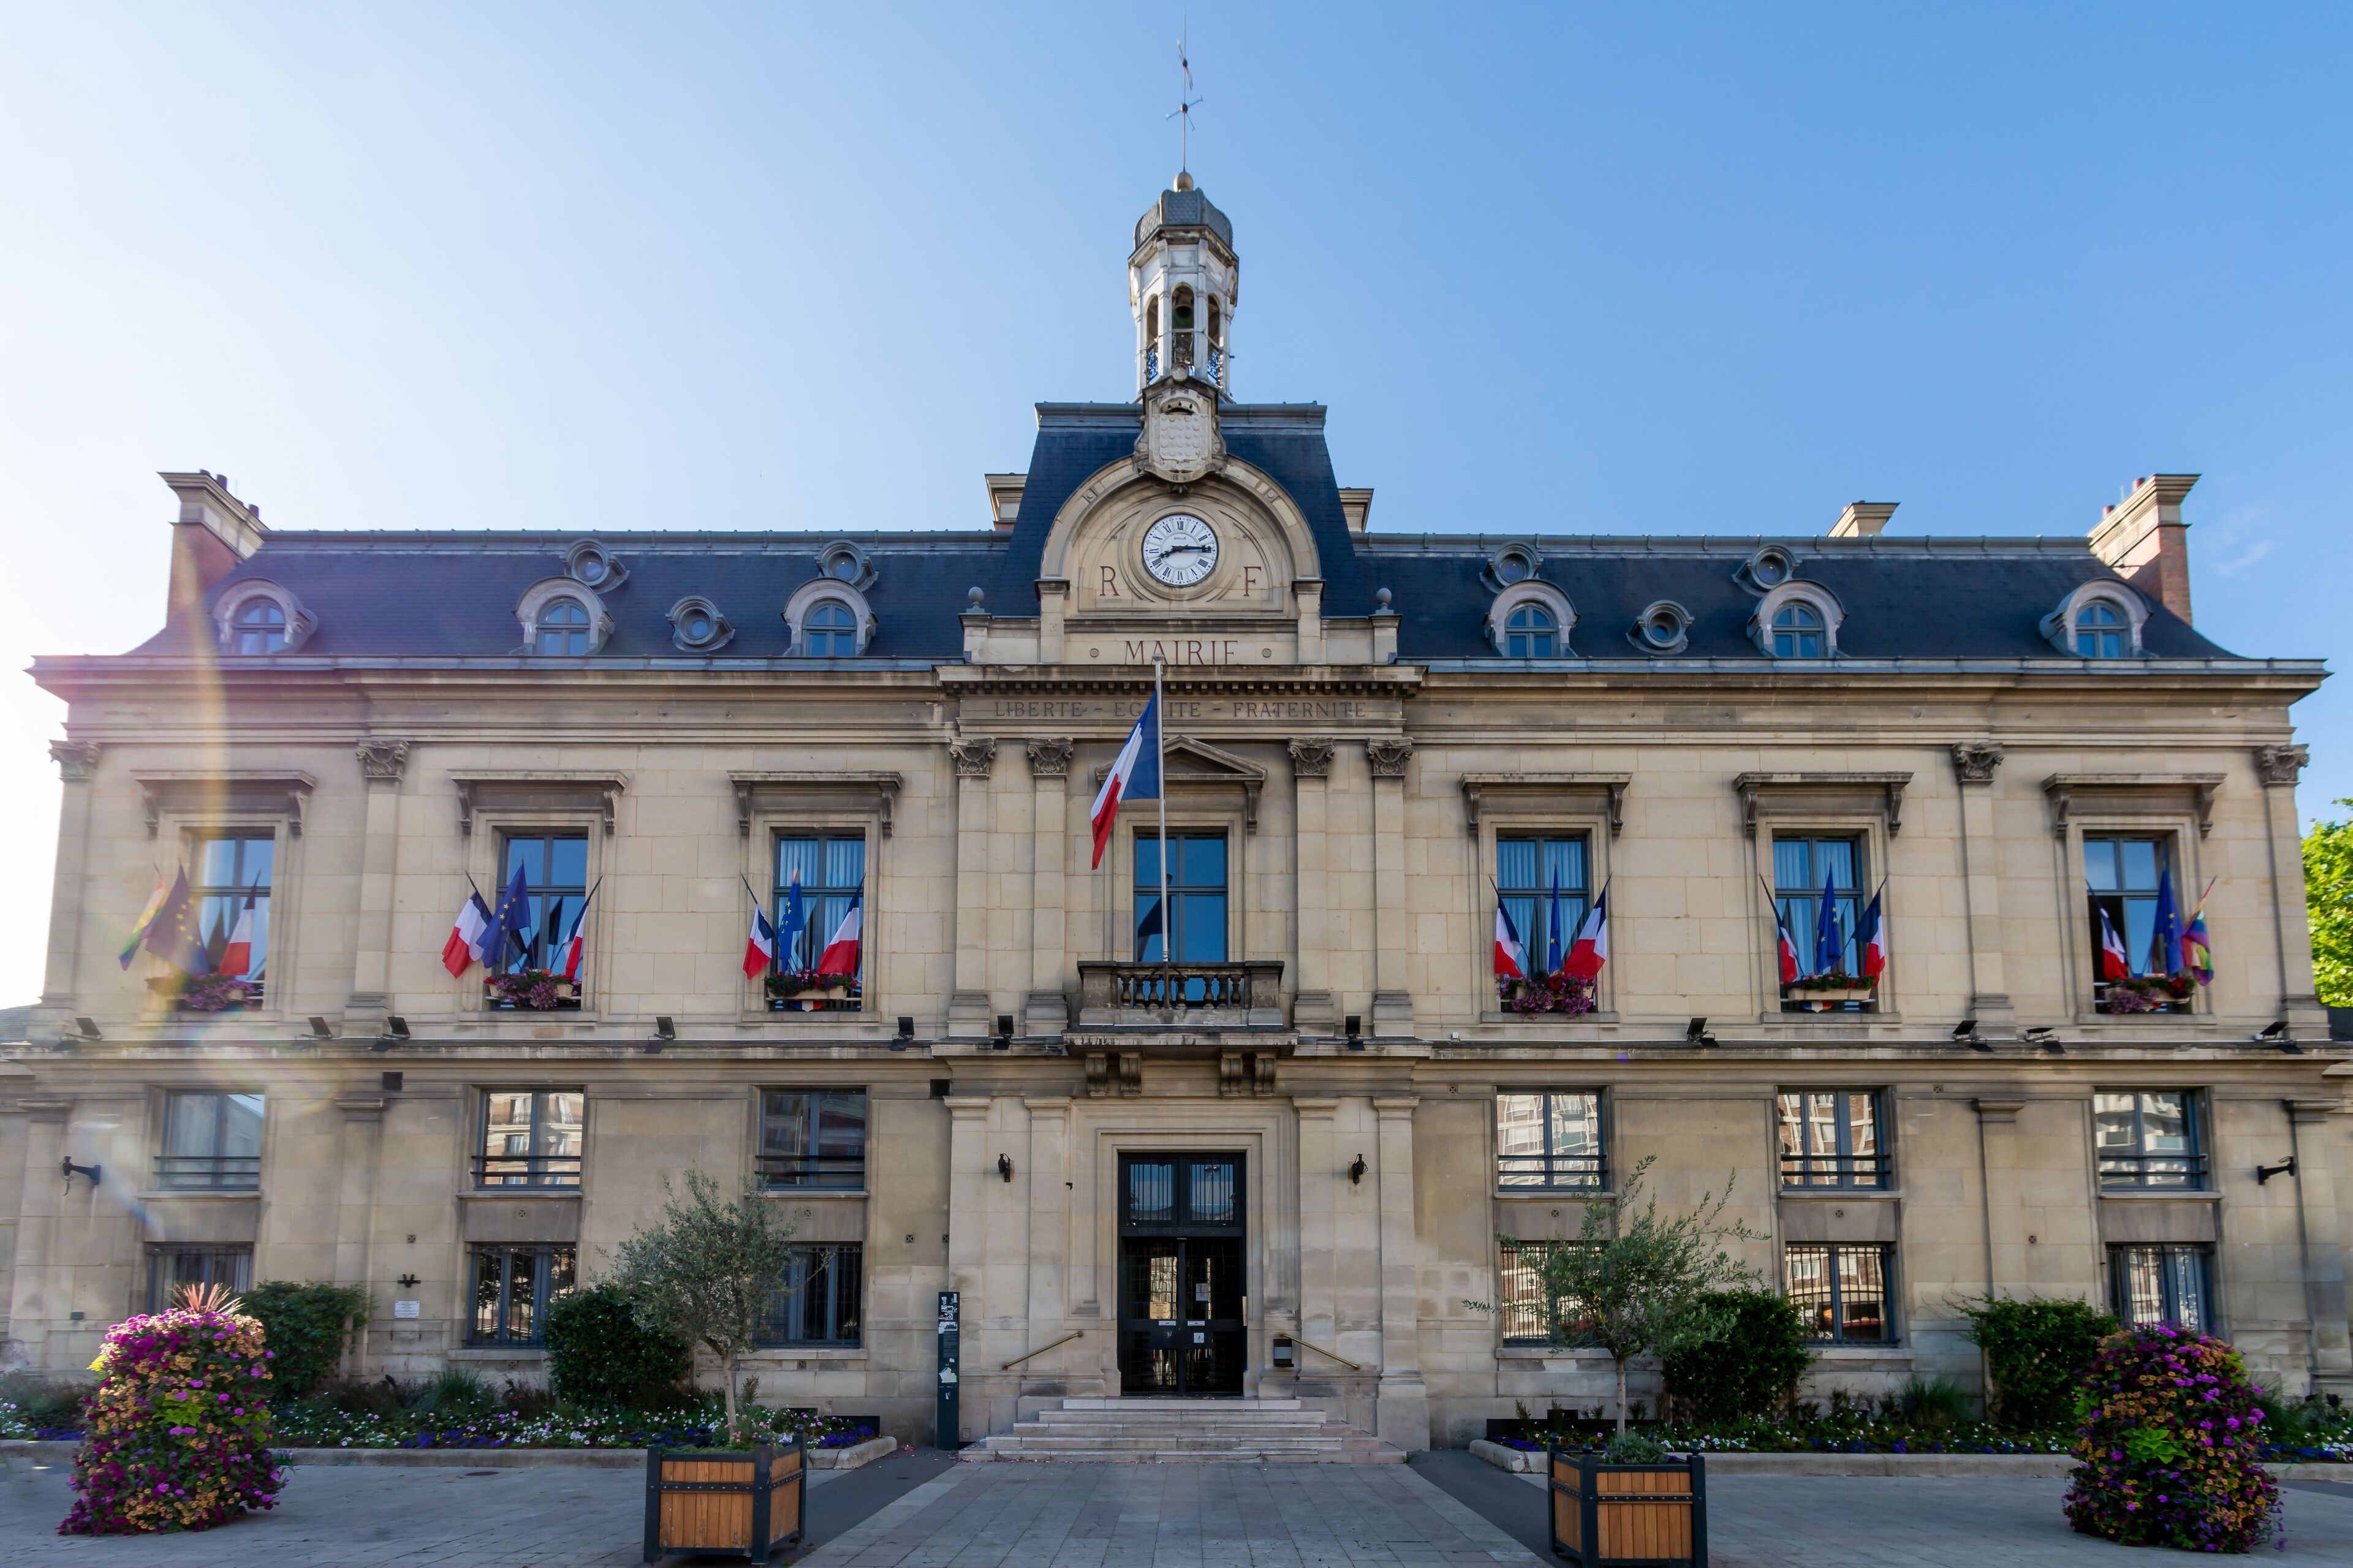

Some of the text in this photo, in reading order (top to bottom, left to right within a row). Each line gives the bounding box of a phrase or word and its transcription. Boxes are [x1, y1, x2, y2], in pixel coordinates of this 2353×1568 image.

[1099, 566, 1262, 597] R F
[1124, 640, 1238, 665] MAIRIE
[995, 701, 1083, 718] LIBERTE
[1113, 702, 1202, 718] EGITE
[1232, 702, 1366, 718] FRATERNITE
